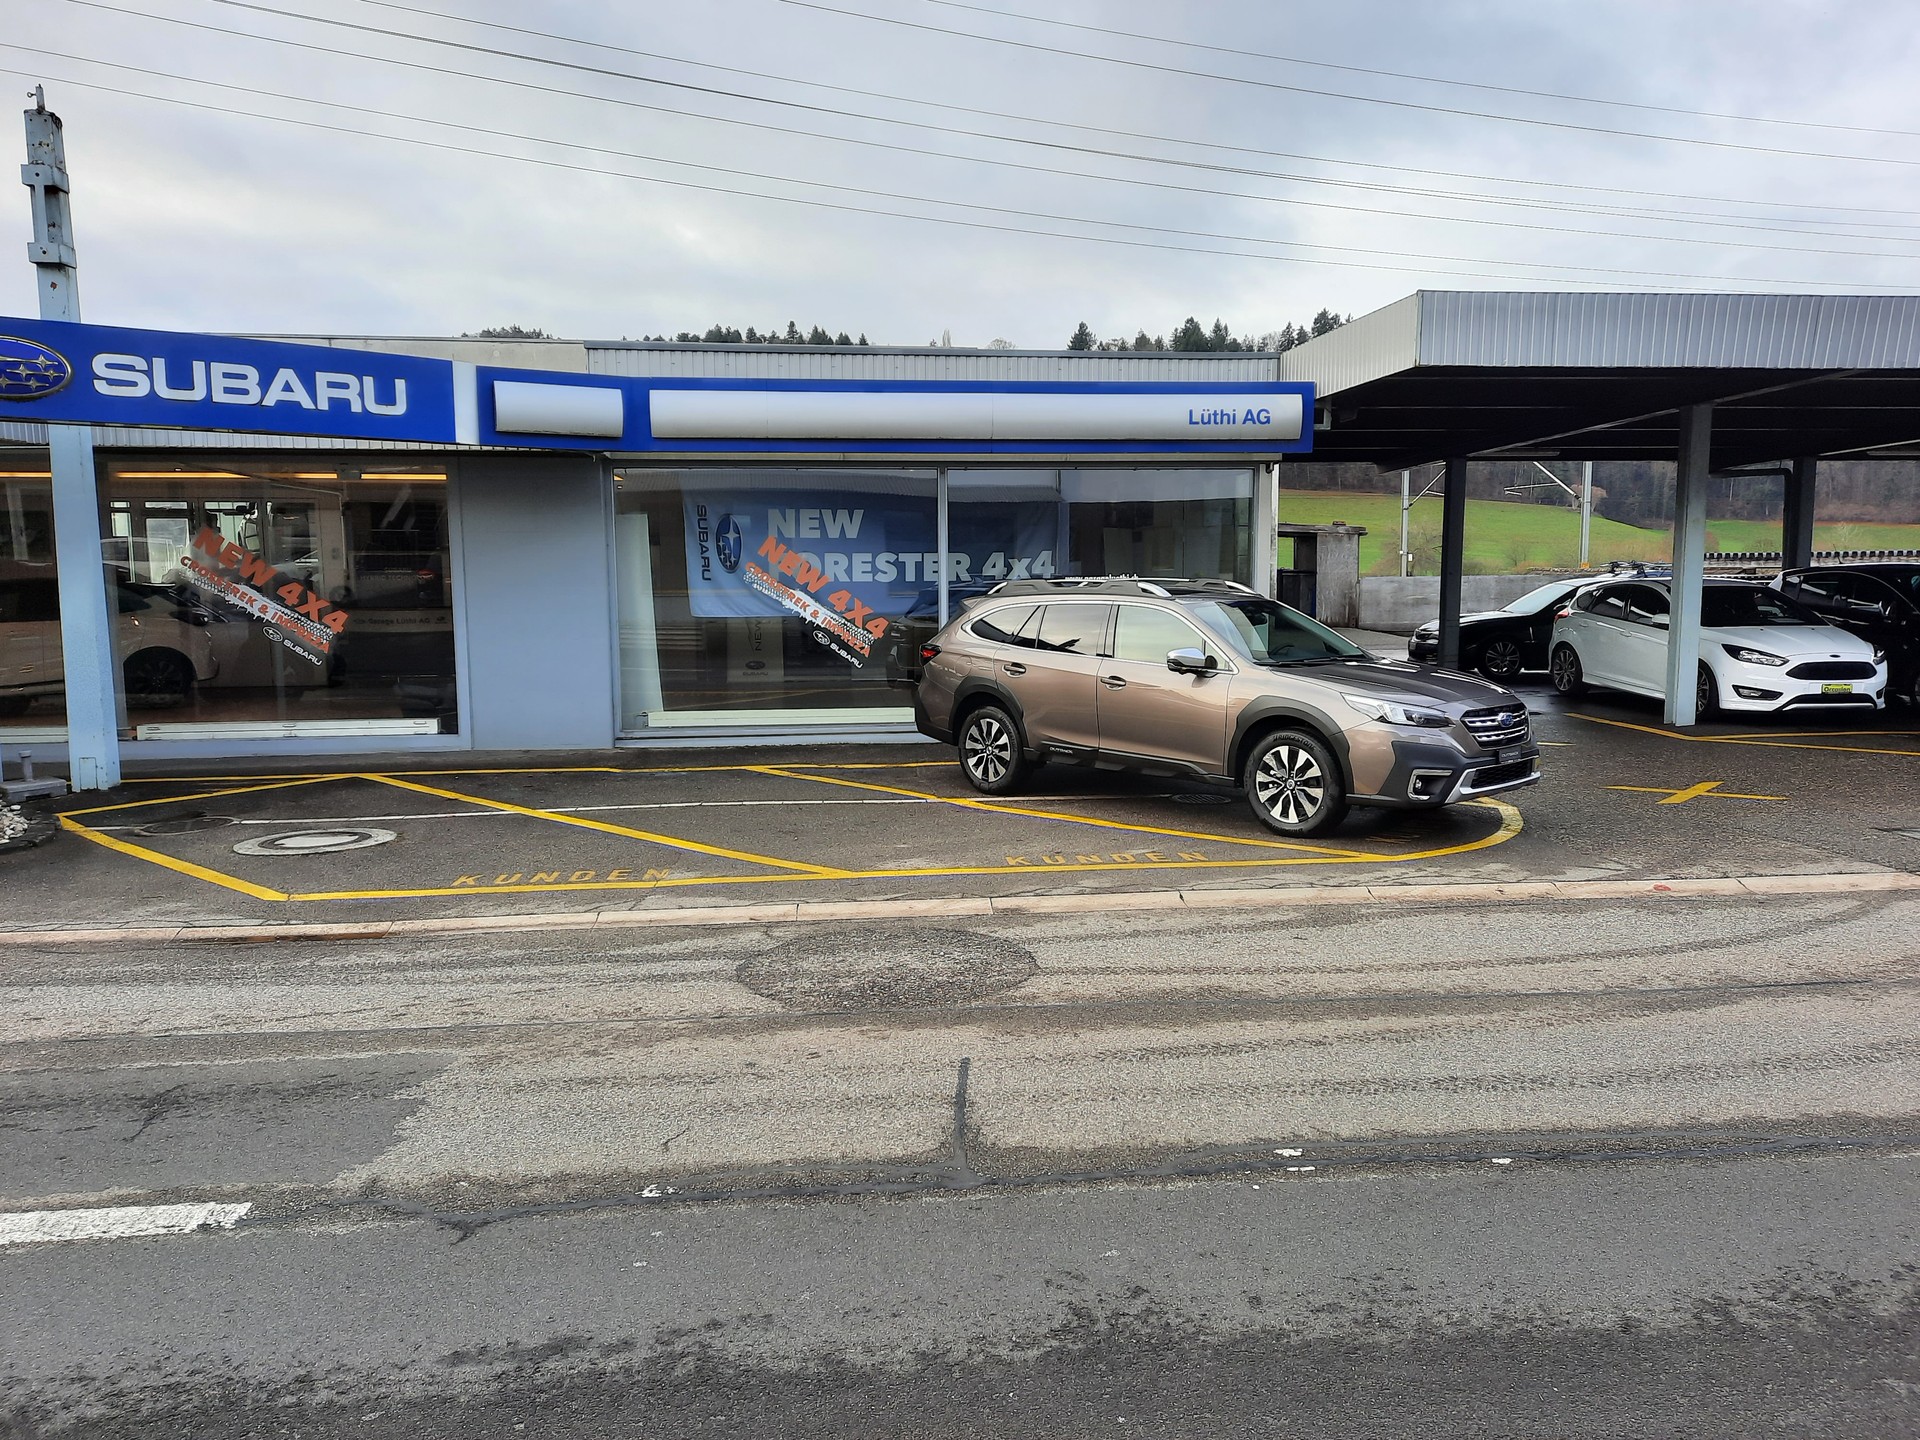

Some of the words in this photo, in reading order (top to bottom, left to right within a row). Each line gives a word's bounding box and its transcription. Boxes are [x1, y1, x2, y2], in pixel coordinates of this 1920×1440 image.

[92, 353, 407, 416] SUBARU
[1188, 409, 1236, 425] Lüthi
[1242, 409, 1271, 425] AG
[767, 509, 864, 539] NEW
[193, 527, 277, 587] NEW
[696, 504, 711, 581] SUBARU
[758, 535, 832, 594] NEW
[257, 604, 269, 616] &
[809, 609, 820, 621] &
[820, 617, 871, 658] IMPREZA
[284, 639, 323, 667] SUBARU
[829, 642, 864, 669] SUBARU
[1005, 852, 1209, 866] KUNDEN
[451, 868, 670, 886] KUNDEN
